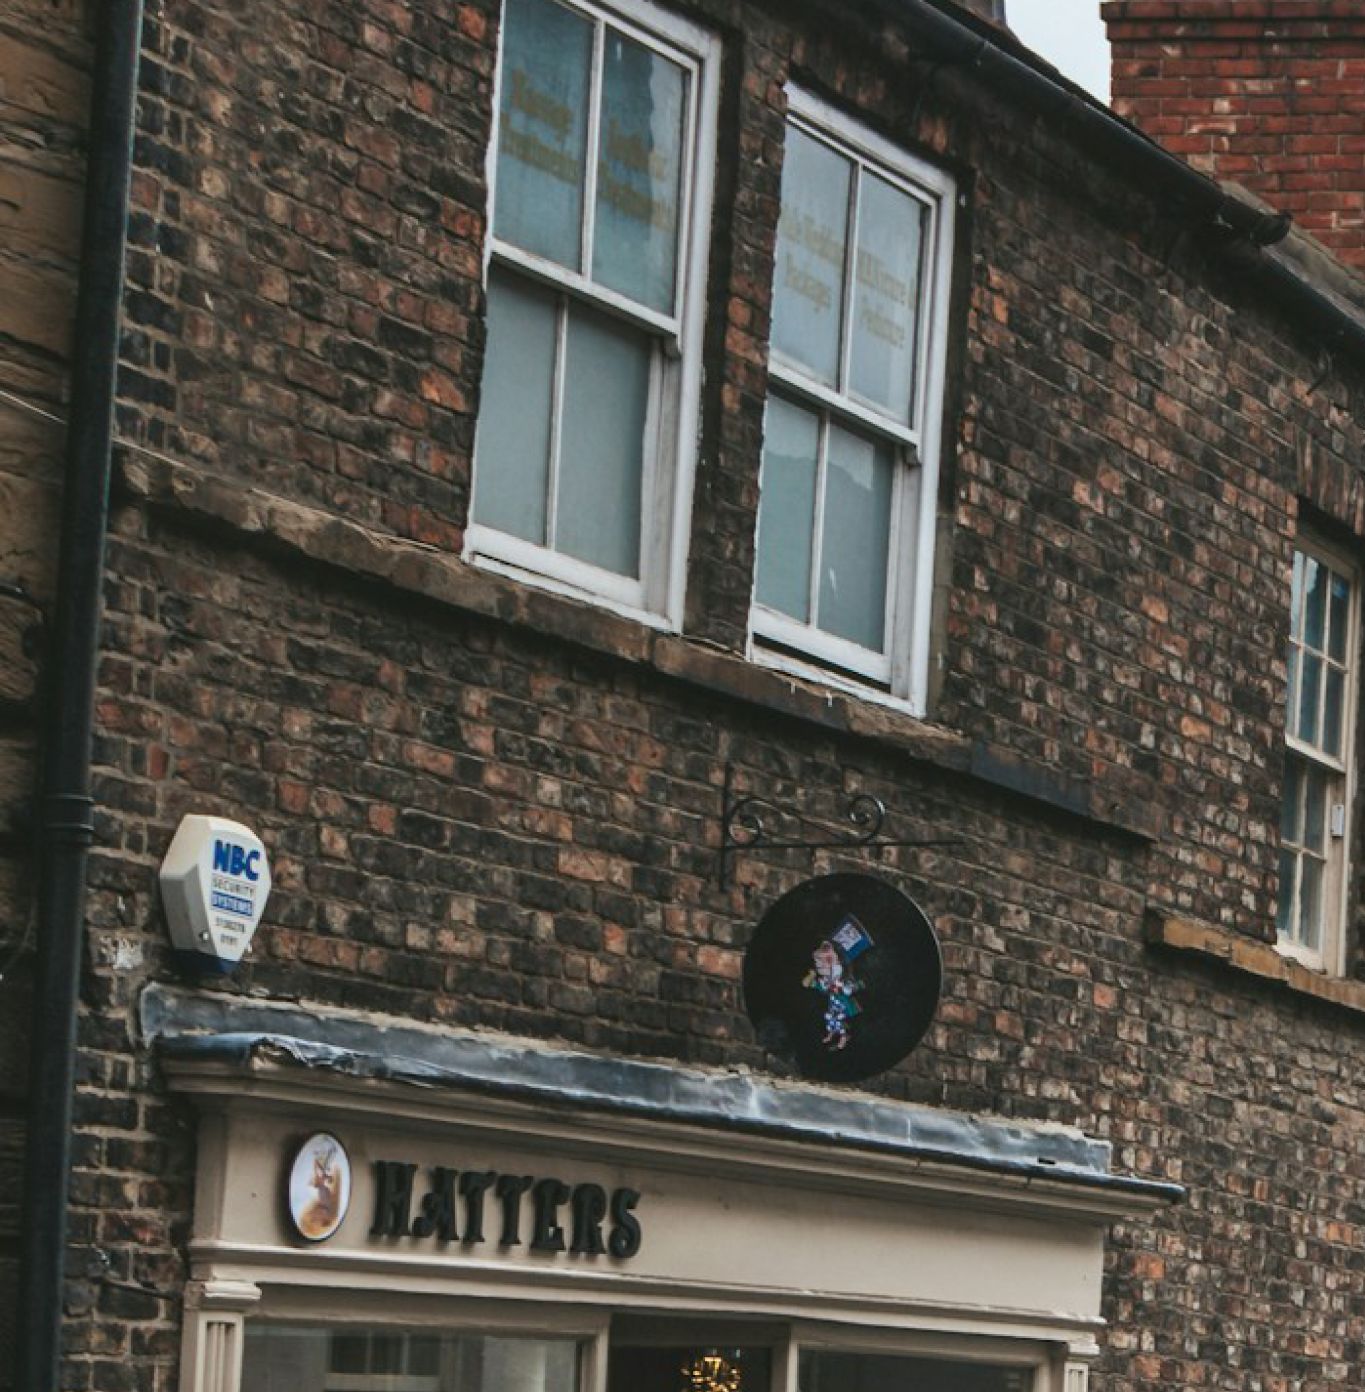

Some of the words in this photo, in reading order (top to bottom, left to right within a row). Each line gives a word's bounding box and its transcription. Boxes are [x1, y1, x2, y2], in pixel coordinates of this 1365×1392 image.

[213, 839, 260, 881] NBC
[212, 876, 257, 898] SECURITY
[211, 892, 254, 915] SYSTEMS
[370, 1159, 642, 1259] HATTERS
